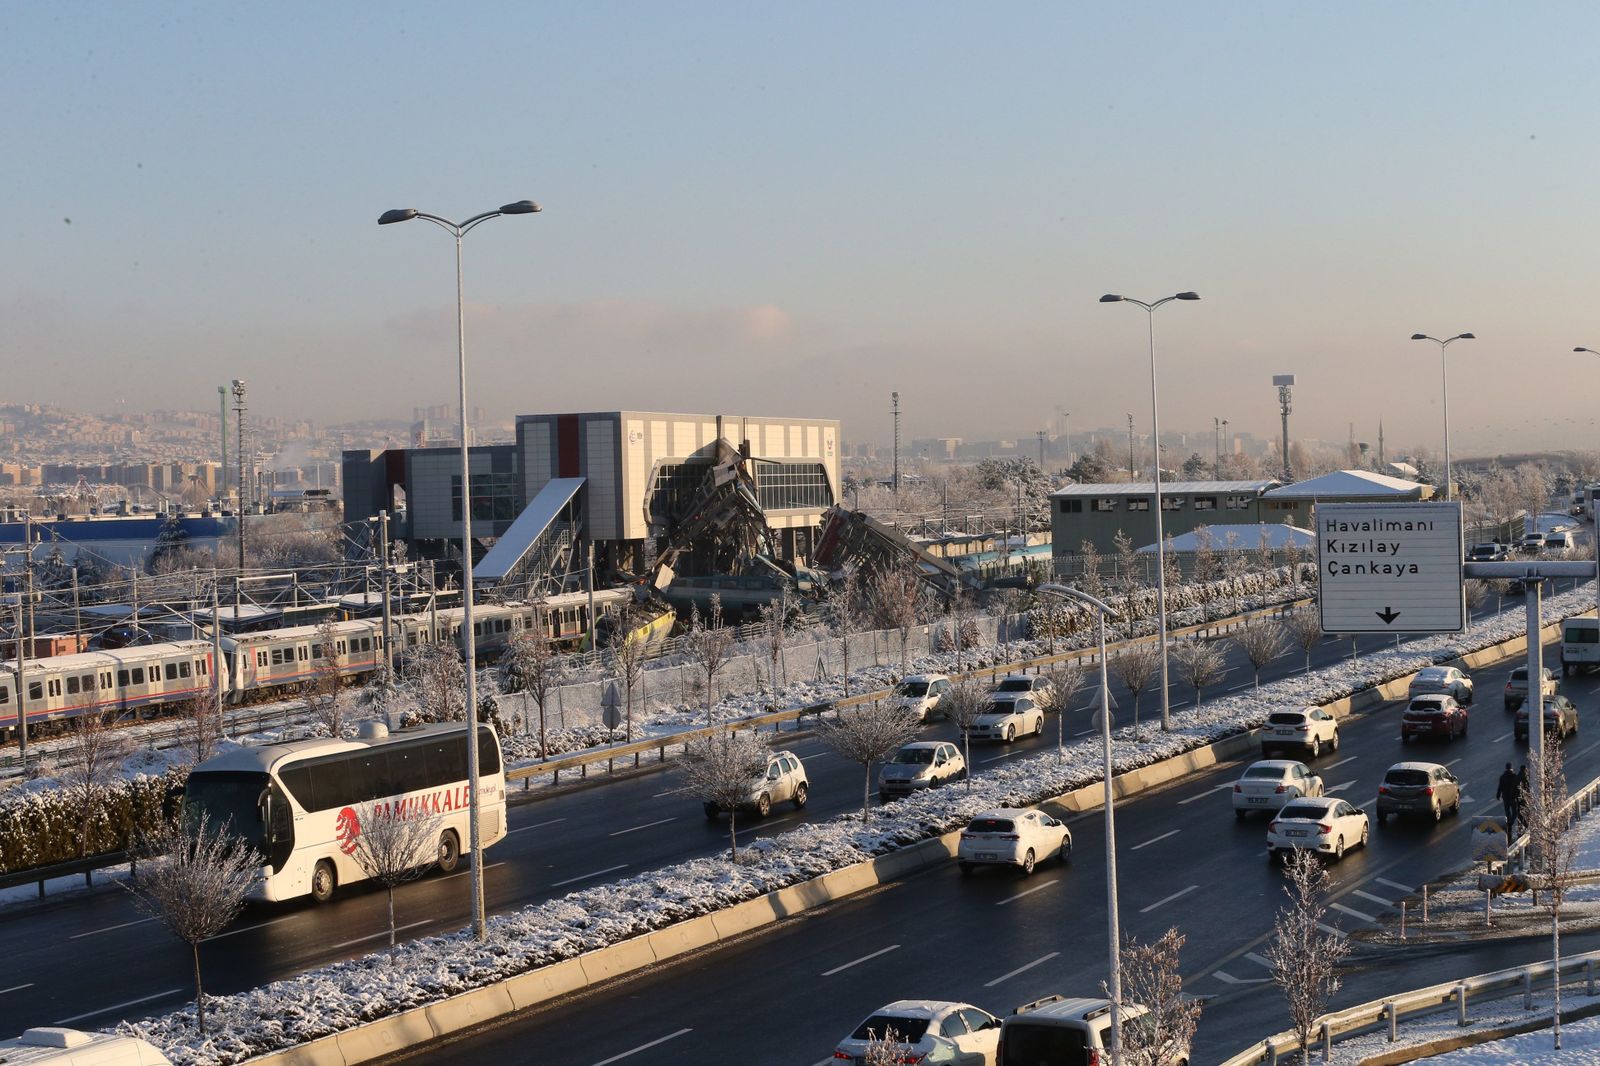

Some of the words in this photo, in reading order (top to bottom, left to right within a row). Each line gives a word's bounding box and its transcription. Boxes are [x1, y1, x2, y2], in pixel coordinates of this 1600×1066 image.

[1326, 519, 1433, 532] Havalimanı
[1327, 539, 1400, 556] Kızılay
[1328, 561, 1419, 577] Çankaya
